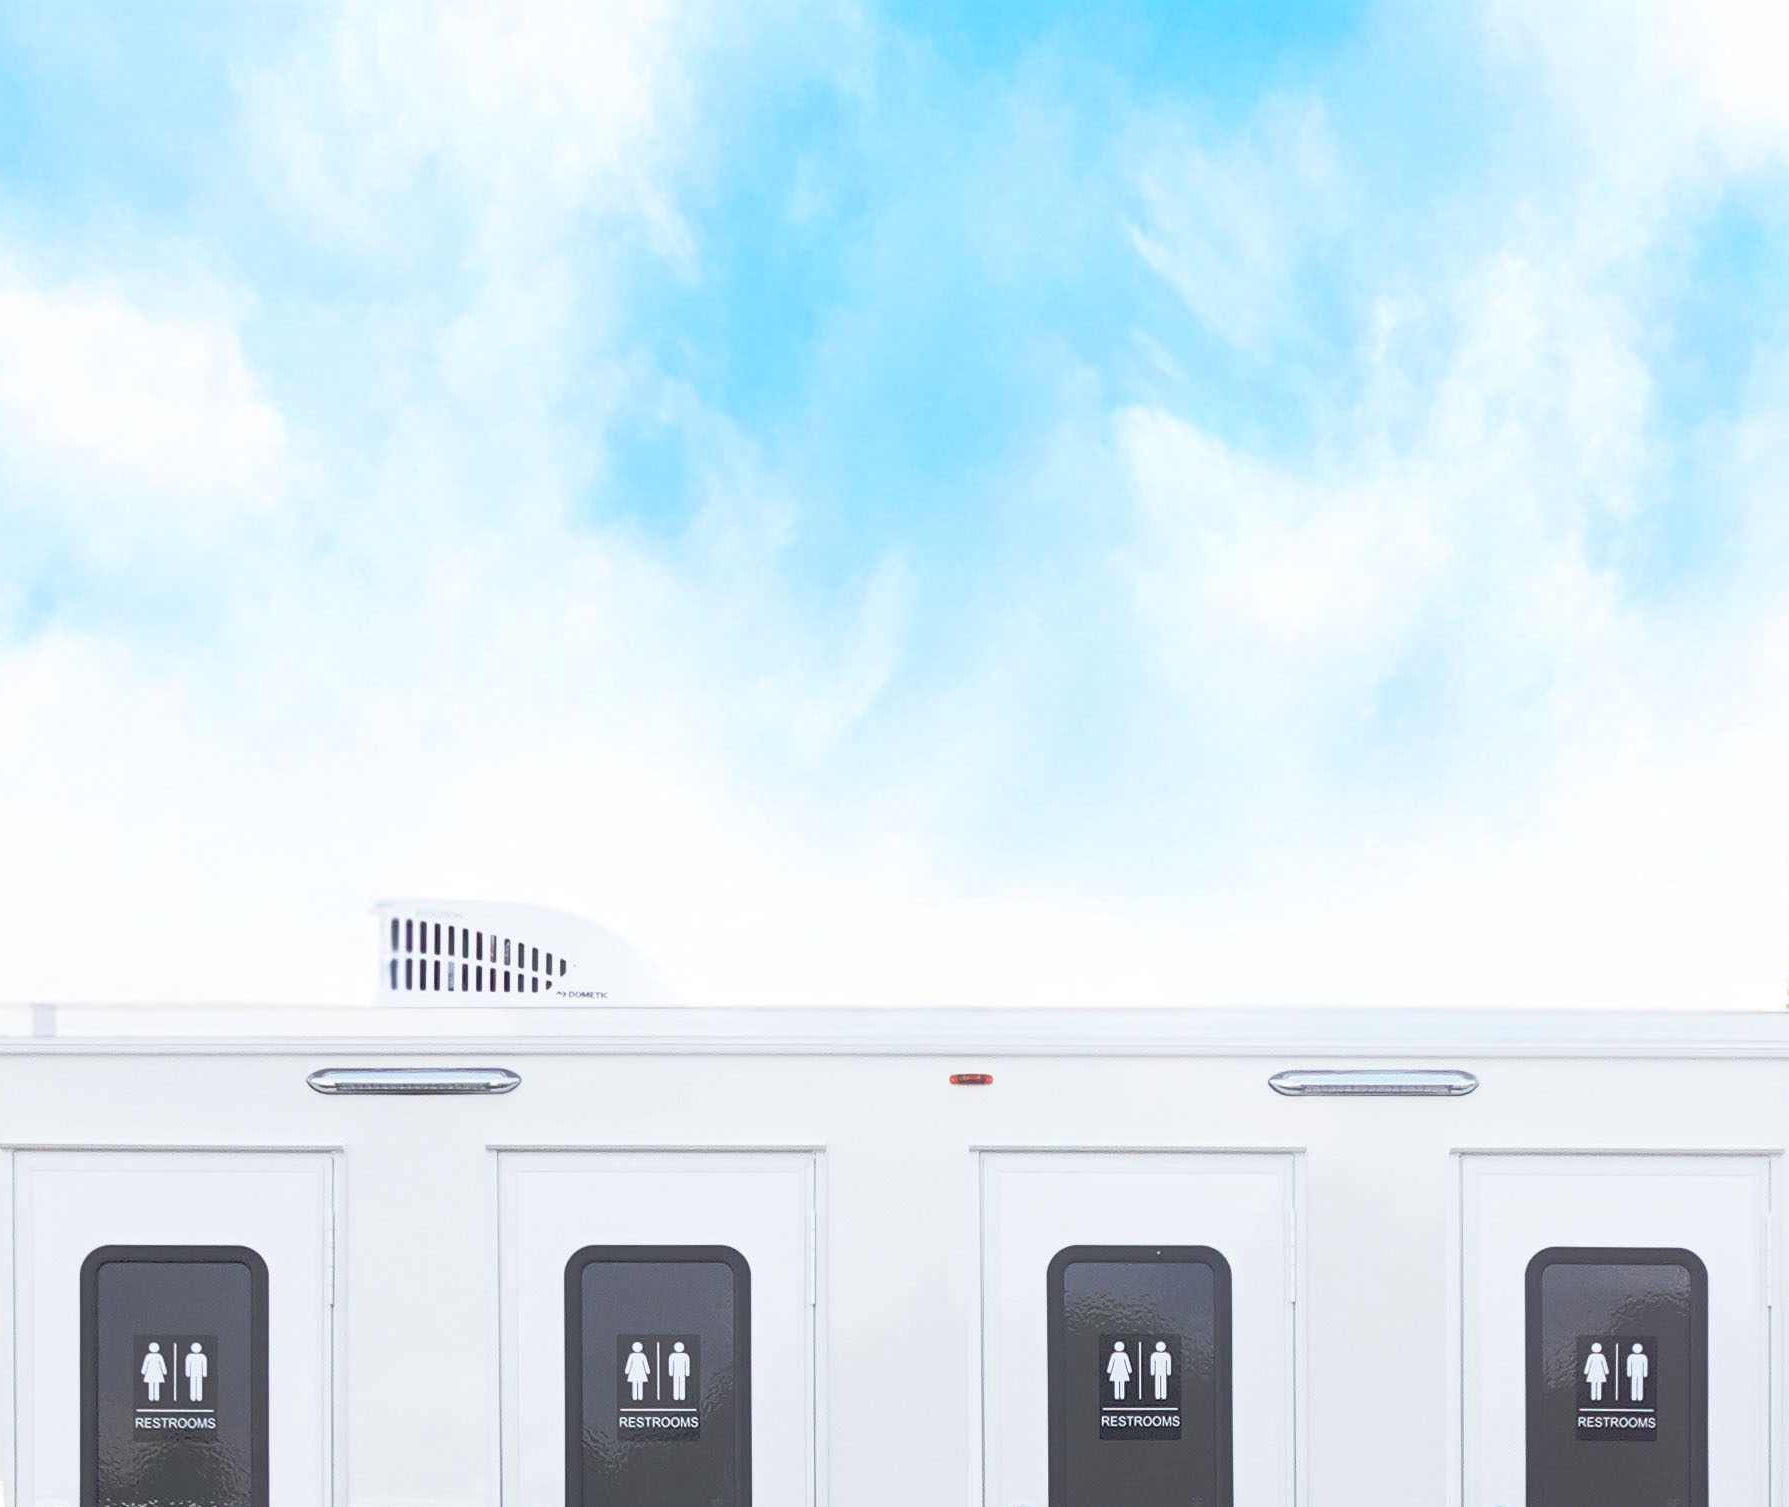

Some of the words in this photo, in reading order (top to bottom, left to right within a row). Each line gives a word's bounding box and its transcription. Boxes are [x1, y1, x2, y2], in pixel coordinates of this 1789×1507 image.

[134, 1416, 217, 1430] RESTROOMS
[618, 1416, 699, 1429] RESTROOMS
[1101, 1415, 1181, 1428] RESTROOMS
[1577, 1416, 1657, 1429] RESTROOMS
